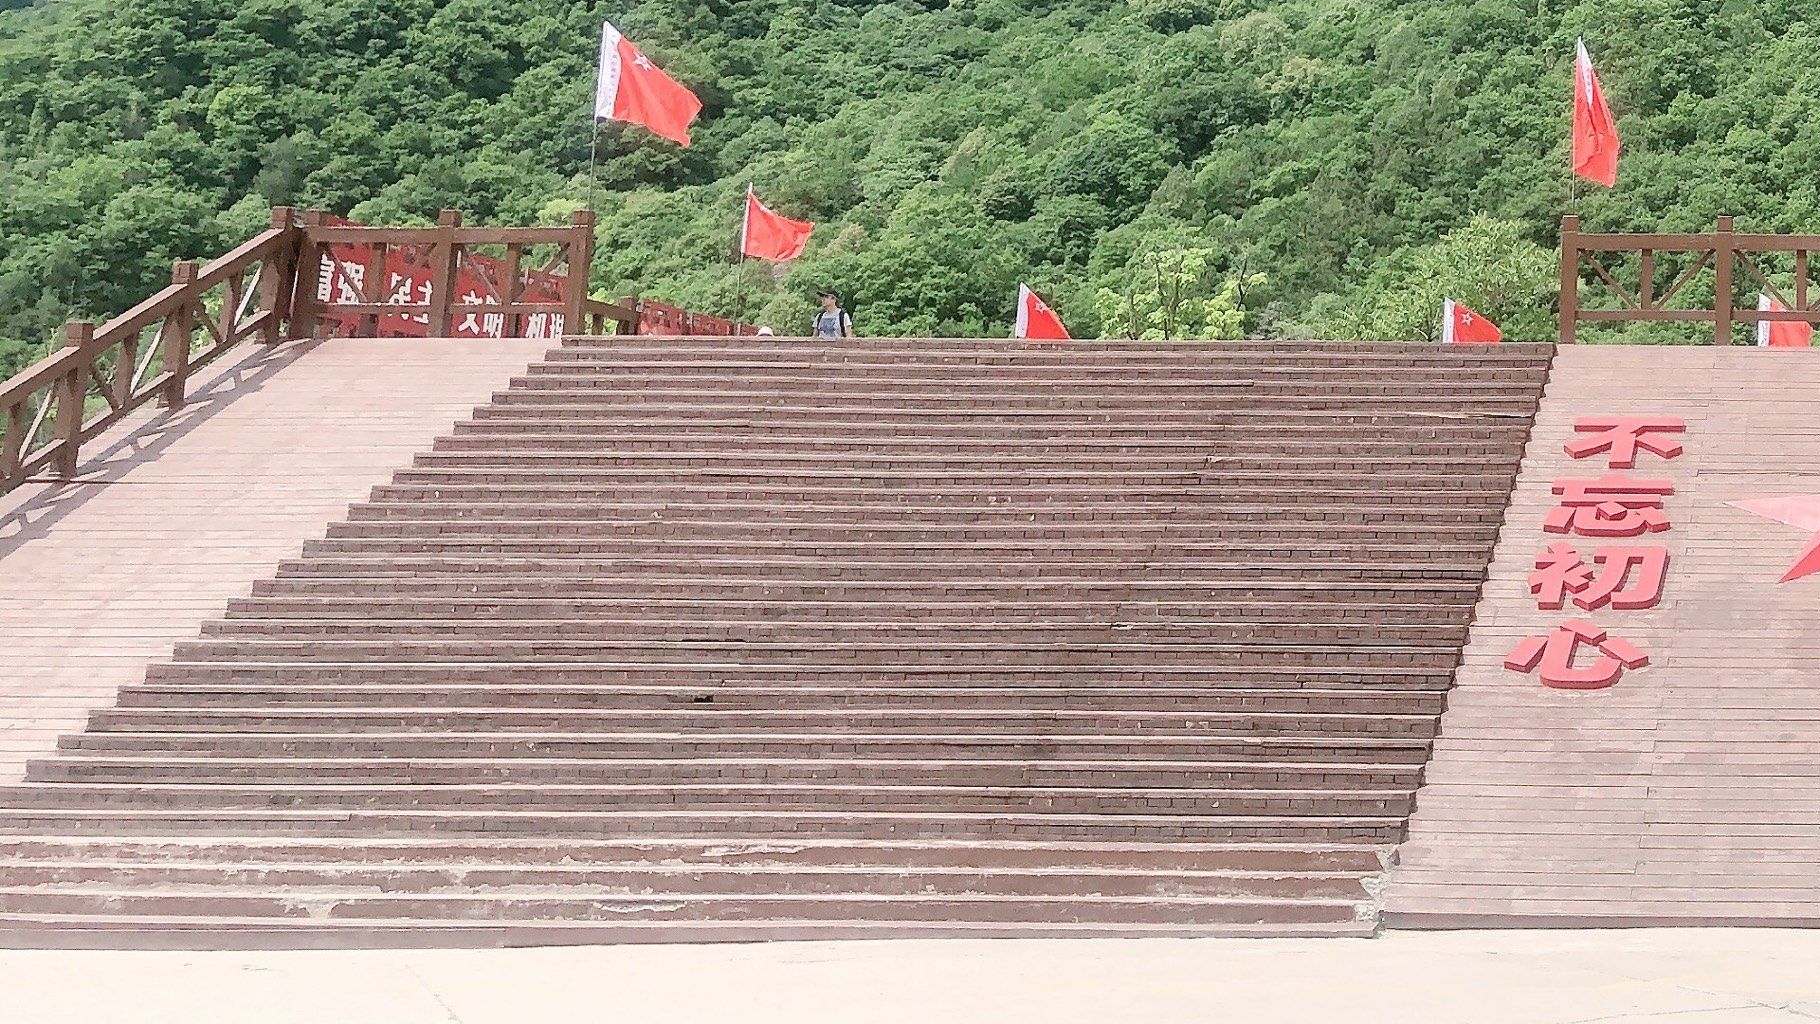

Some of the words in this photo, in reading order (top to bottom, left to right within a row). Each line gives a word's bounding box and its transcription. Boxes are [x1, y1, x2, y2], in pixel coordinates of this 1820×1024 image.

[457, 290, 505, 338] 文明
[1505, 417, 1687, 689] 不忘初心
